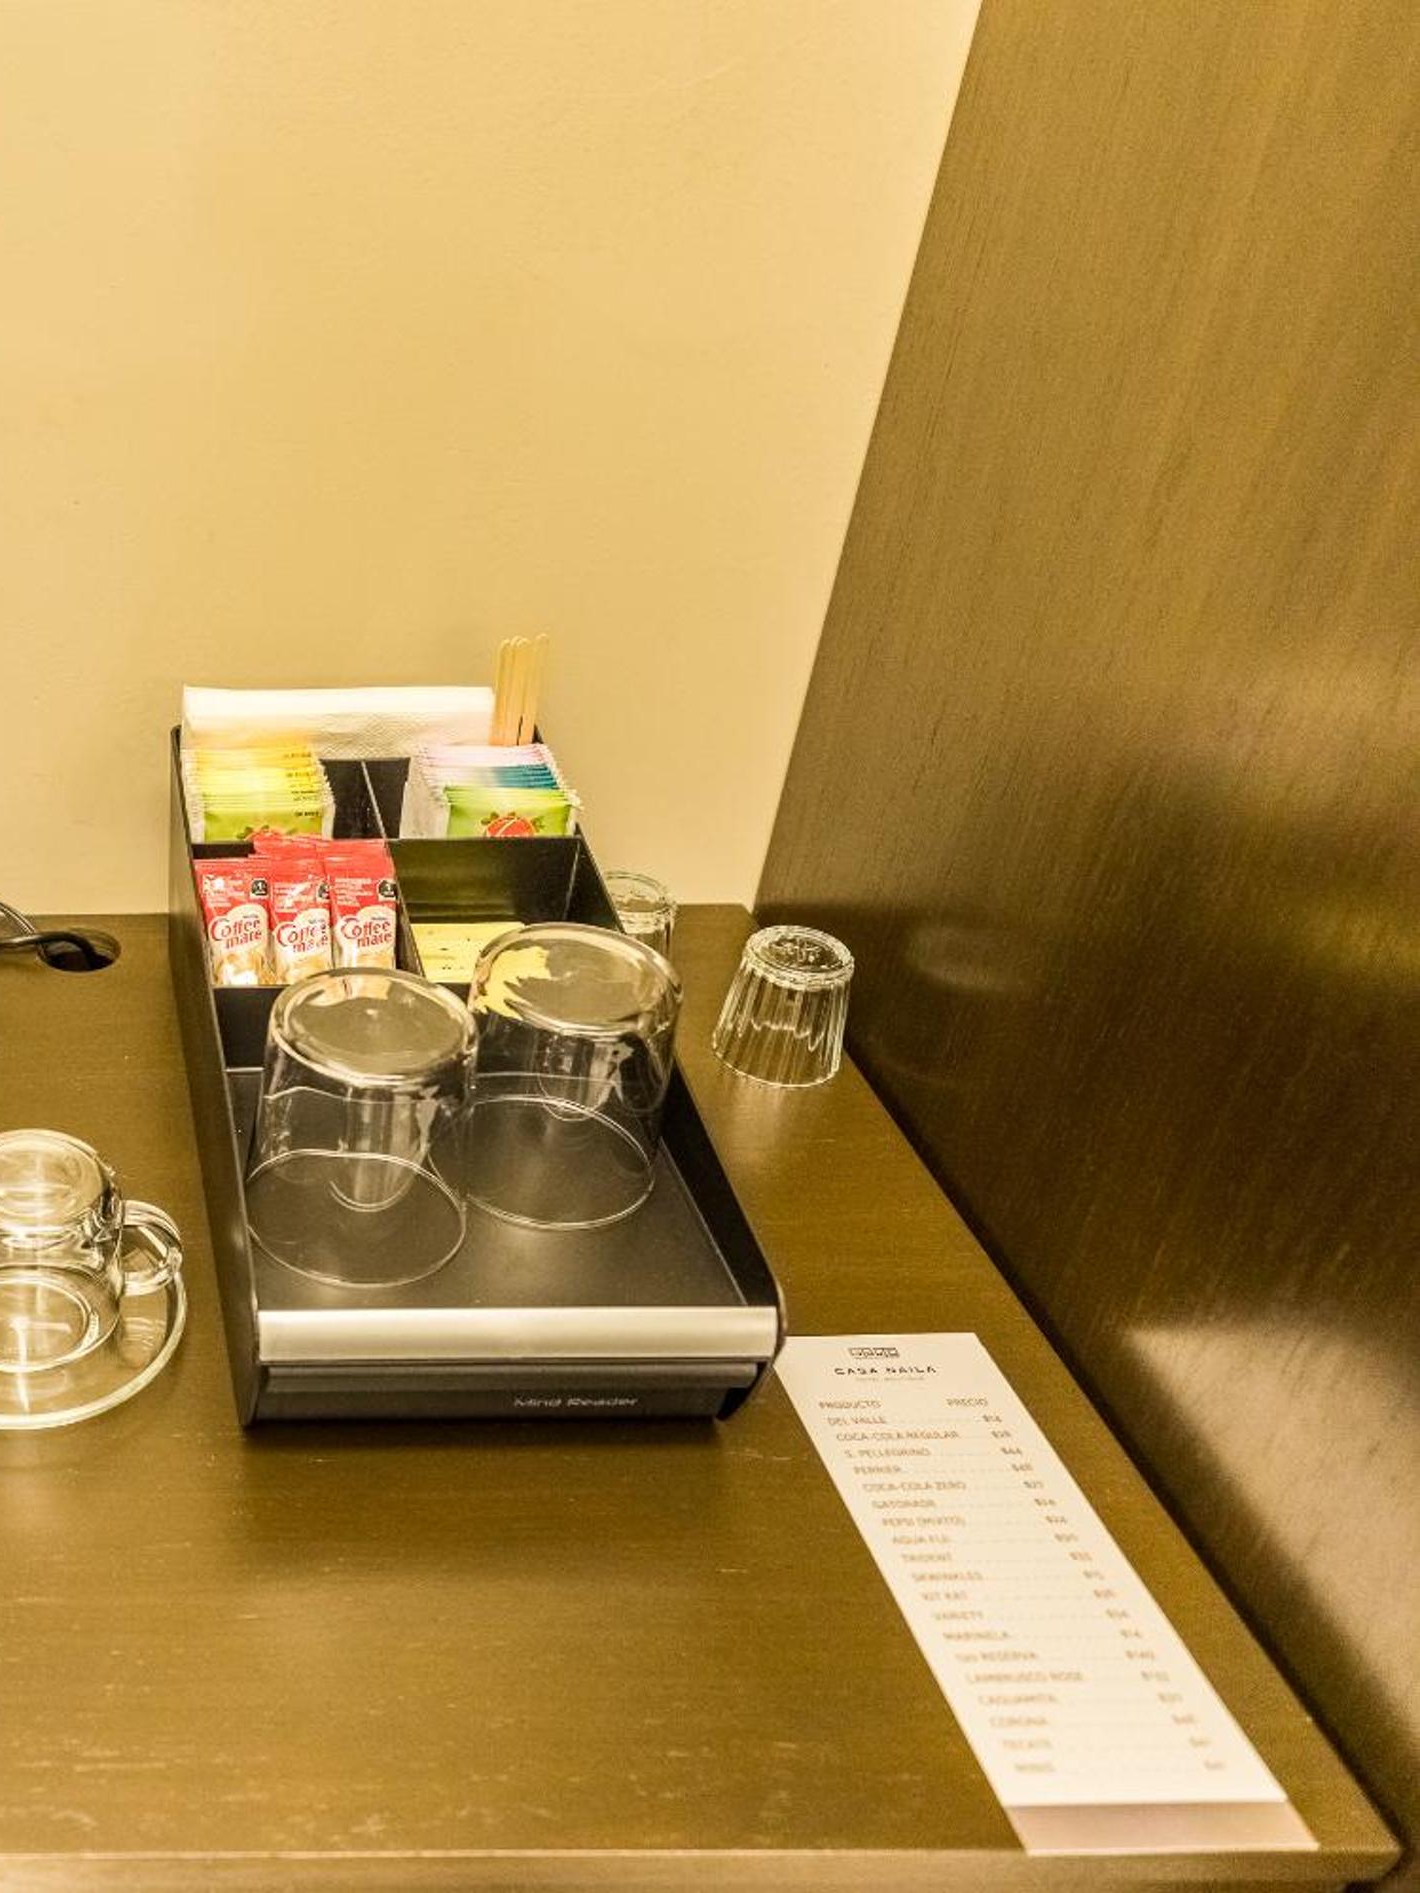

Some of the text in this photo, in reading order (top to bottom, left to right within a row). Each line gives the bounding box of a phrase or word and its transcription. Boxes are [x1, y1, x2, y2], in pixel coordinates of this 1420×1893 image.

[211, 917, 261, 942] Coffee
[341, 917, 391, 940] Coffee
[226, 931, 262, 949] mate
[357, 931, 392, 948] mate
[834, 1366, 937, 1375] CASA NAILA
[514, 1397, 637, 1407] Mind Reader
[818, 1398, 988, 1409] PRODUCTO PRECIO
[852, 1415, 887, 1424] VALLE
